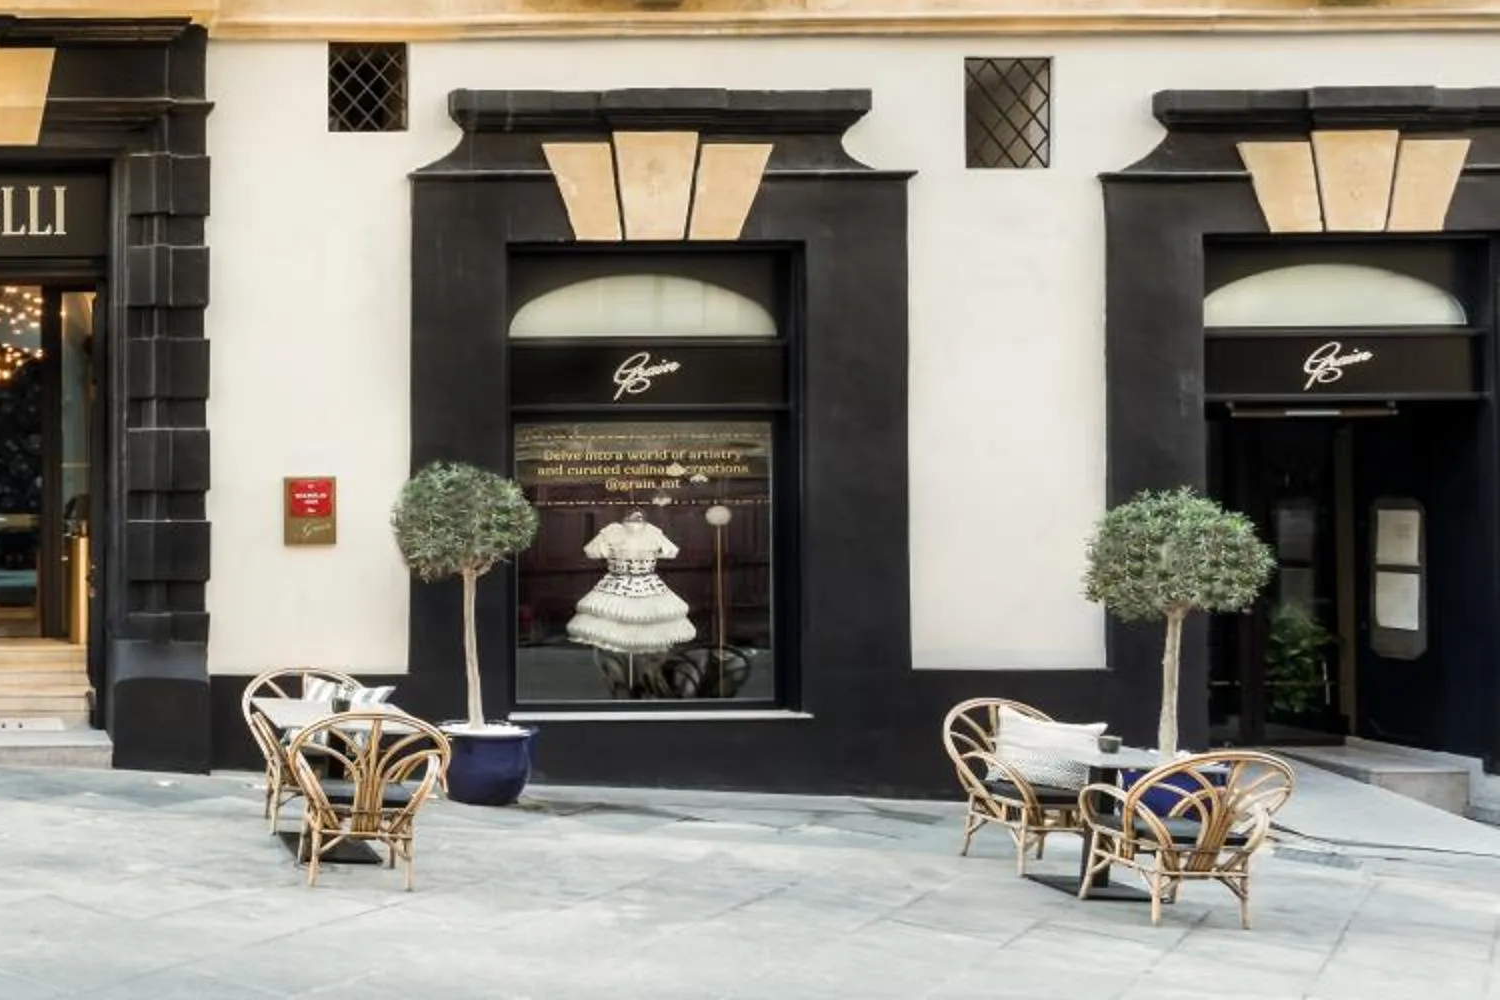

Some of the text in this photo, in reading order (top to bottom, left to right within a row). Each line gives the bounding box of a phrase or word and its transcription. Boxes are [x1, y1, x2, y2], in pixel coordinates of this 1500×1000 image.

[626, 449, 667, 461] world
[671, 449, 687, 460] of
[690, 448, 741, 462] artistry
[537, 462, 749, 476] and curated culina creations
